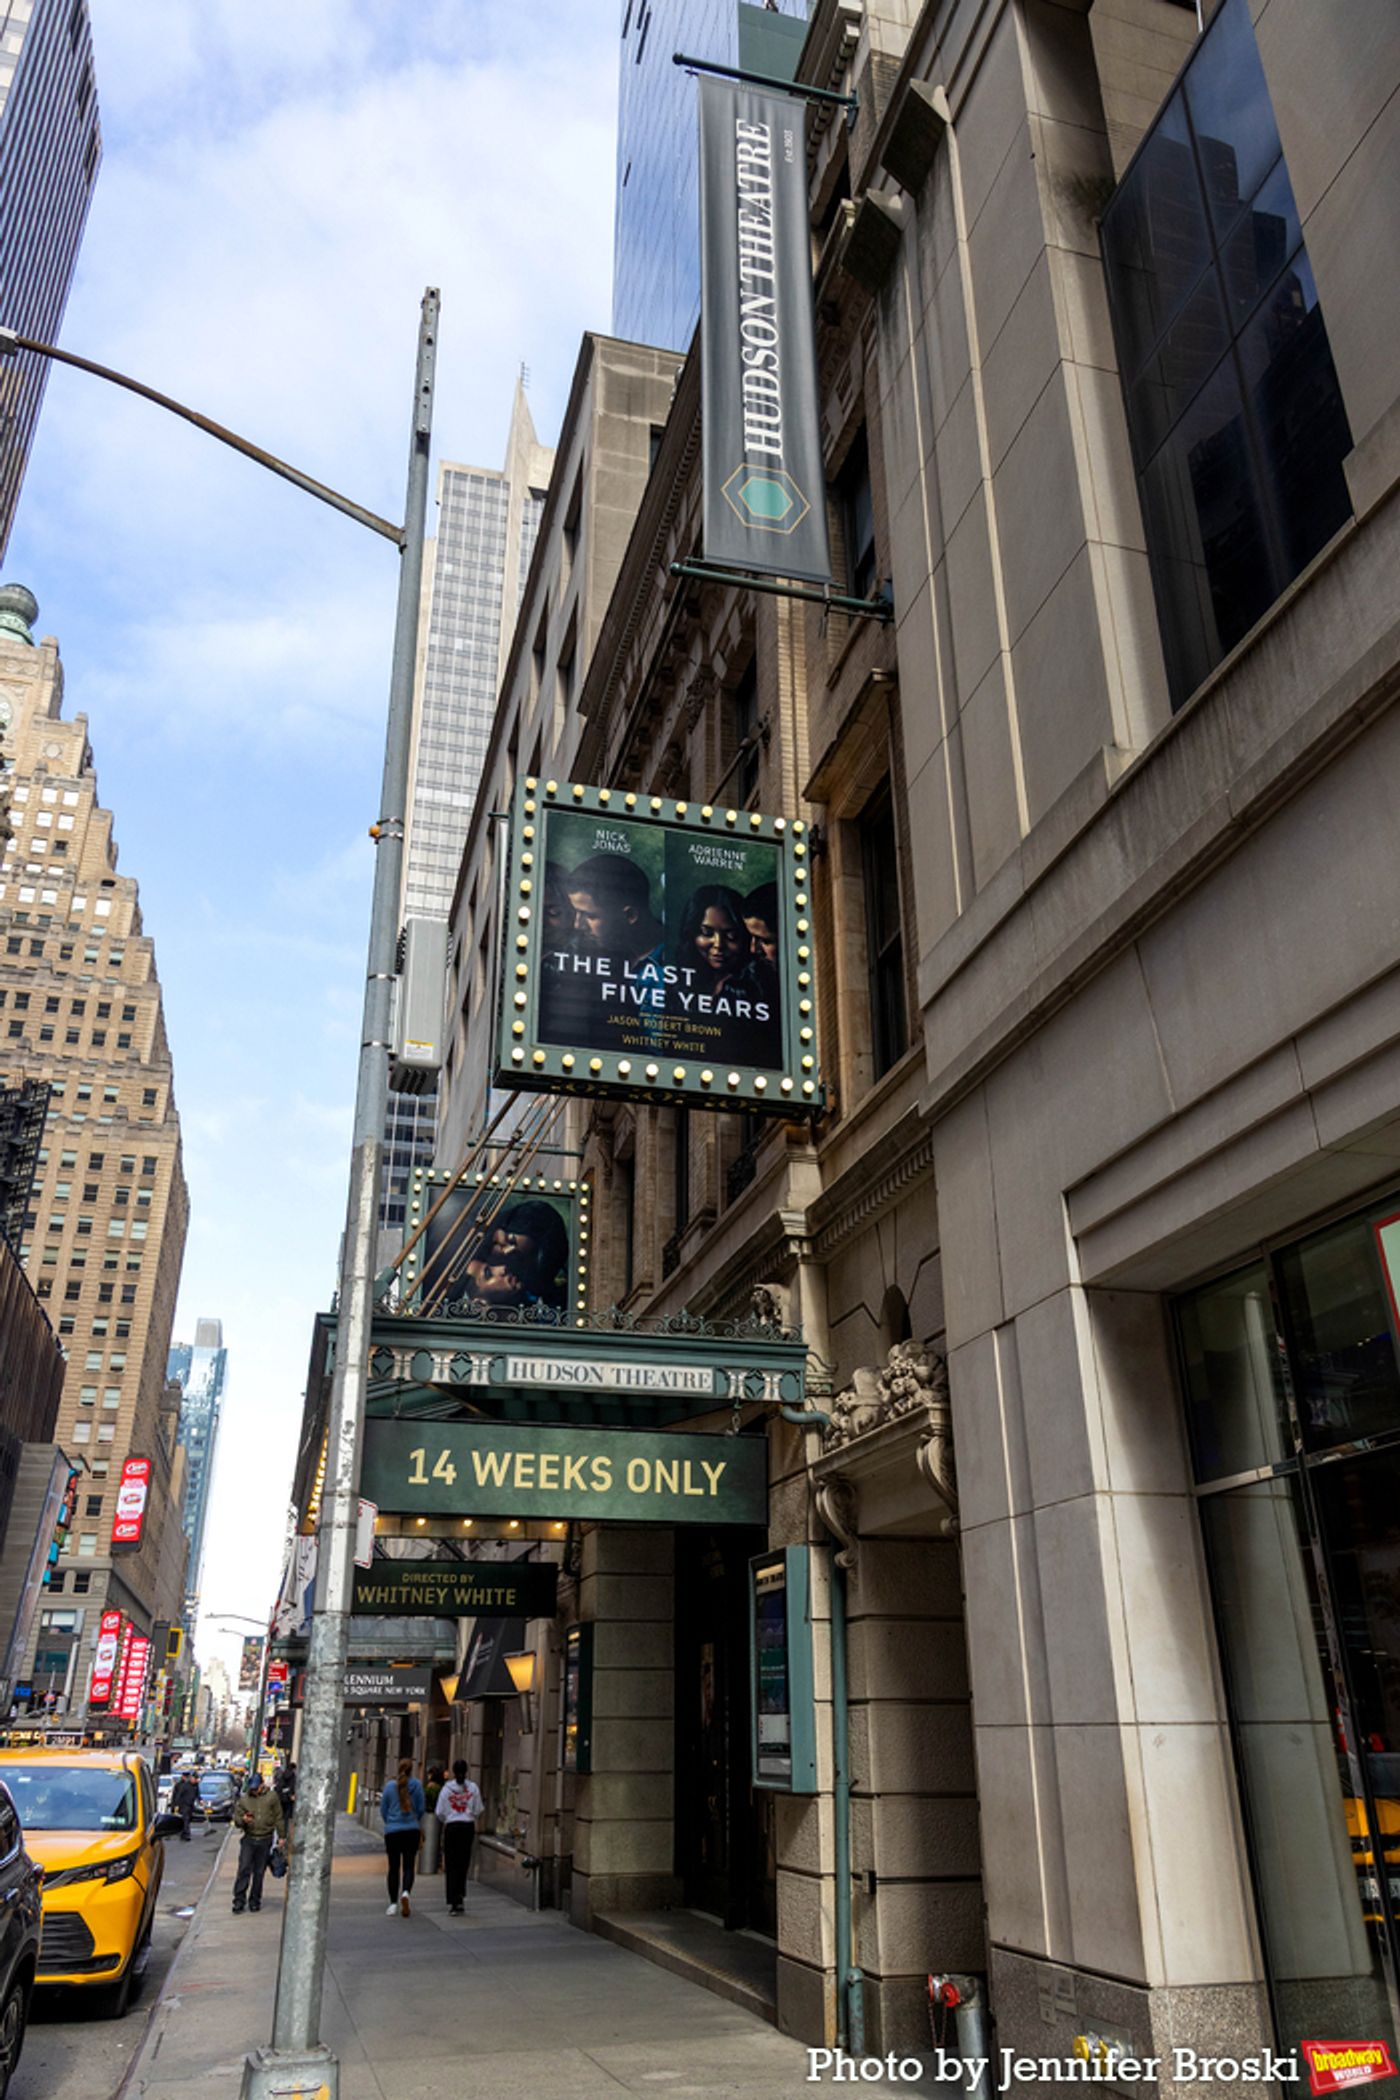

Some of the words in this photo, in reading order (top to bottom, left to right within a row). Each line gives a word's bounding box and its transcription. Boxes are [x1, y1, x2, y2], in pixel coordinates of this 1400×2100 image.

[736, 118, 775, 285] THEATRE
[740, 288, 783, 460] HUDSON
[596, 829, 627, 842] NICK
[592, 840, 631, 853] JONAS
[688, 843, 747, 862] ADRIENNE
[693, 853, 744, 871] WARREN
[554, 952, 612, 976] THE
[623, 960, 697, 986] LAST
[601, 982, 666, 1008] FIVE
[678, 991, 770, 1022] YEARS
[607, 1014, 640, 1027] JASON
[643, 1017, 682, 1032] ROBERT
[684, 1023, 722, 1037] BROWN
[622, 1034, 670, 1049] WHITNEY
[672, 1040, 706, 1053] WHITE
[511, 1361, 604, 1383] HUDSON
[611, 1367, 711, 1389] THEATRE
[407, 1448, 457, 1486] 14
[471, 1450, 613, 1492] WEEKS
[626, 1457, 726, 1496] ONLY
[401, 1573, 457, 1584] DIRECTED
[460, 1574, 475, 1584] BY
[357, 1586, 449, 1605] WHITNEY
[454, 1588, 516, 1606] WHITE
[344, 1674, 394, 1685] LENNIUM
[384, 1686, 403, 1695] NEW
[405, 1686, 426, 1696] YORK
